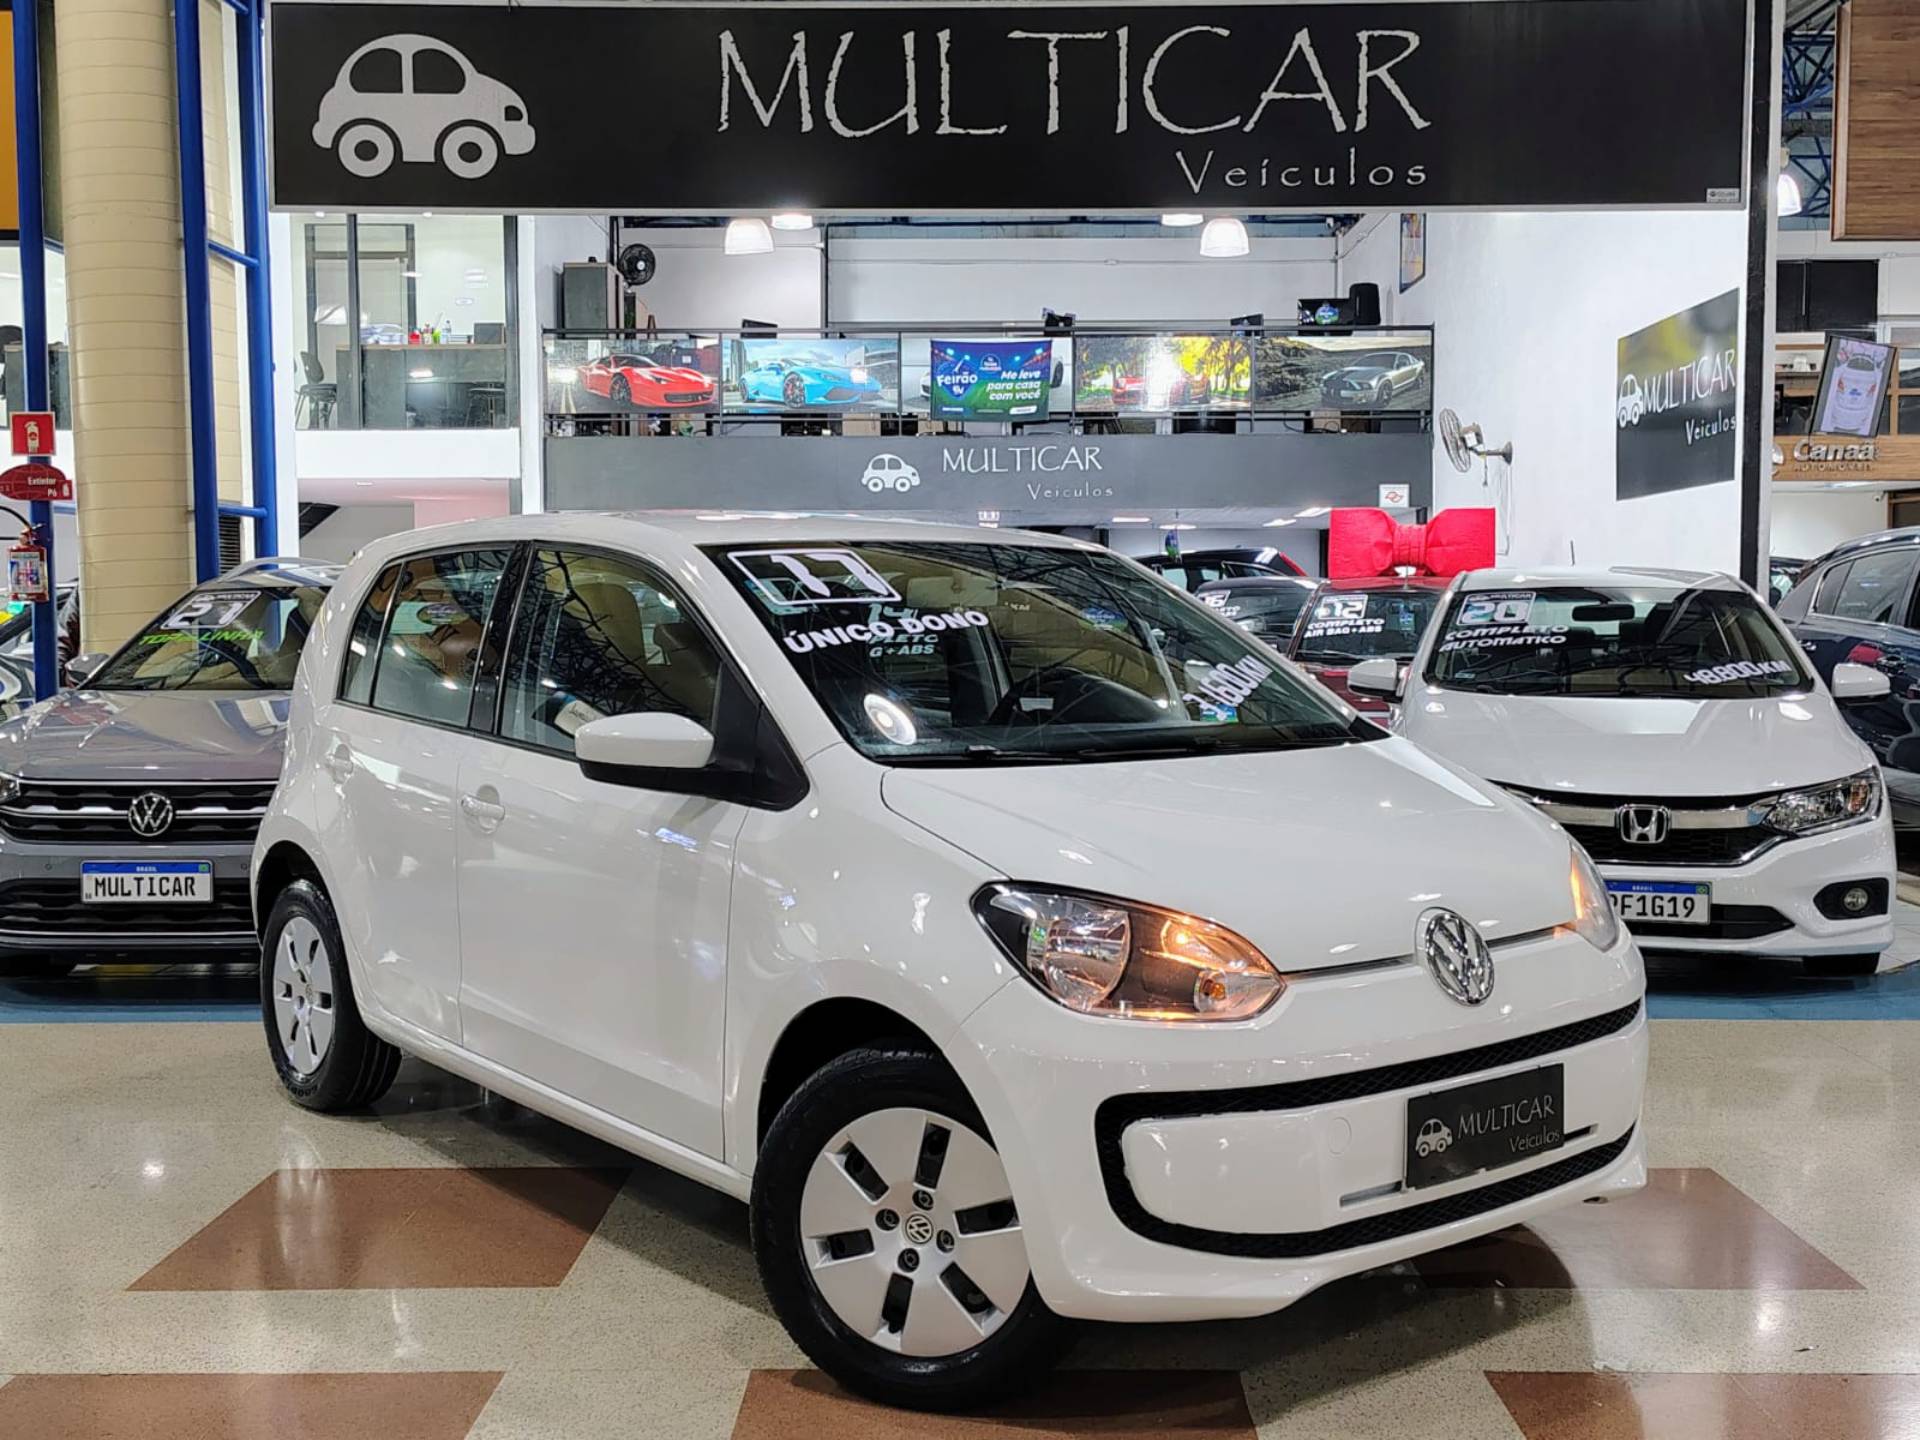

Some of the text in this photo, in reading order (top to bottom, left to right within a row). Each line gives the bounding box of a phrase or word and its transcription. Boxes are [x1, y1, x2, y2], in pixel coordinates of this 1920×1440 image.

[718, 25, 1431, 138] MULTICAR
[1175, 147, 1428, 194] Veículos
[936, 371, 978, 387] Feirão
[1001, 369, 1041, 380] Me leve
[1644, 348, 1736, 415] MULTICAR
[986, 381, 1041, 392] para casa
[989, 389, 1041, 400] com você
[942, 446, 1103, 473] MULTICAR
[164, 602, 243, 626] 21
[1462, 601, 1530, 623] 20
[783, 610, 990, 654] ÚNICO DONO
[1303, 629, 1324, 638] AIR
[1307, 618, 1385, 630] COMPLETO
[1445, 624, 1569, 641] COMPLETO
[1438, 635, 1567, 652] AUTOMATICO
[95, 876, 196, 897] MULTICAR
[1457, 1094, 1556, 1140] MULTICAR
